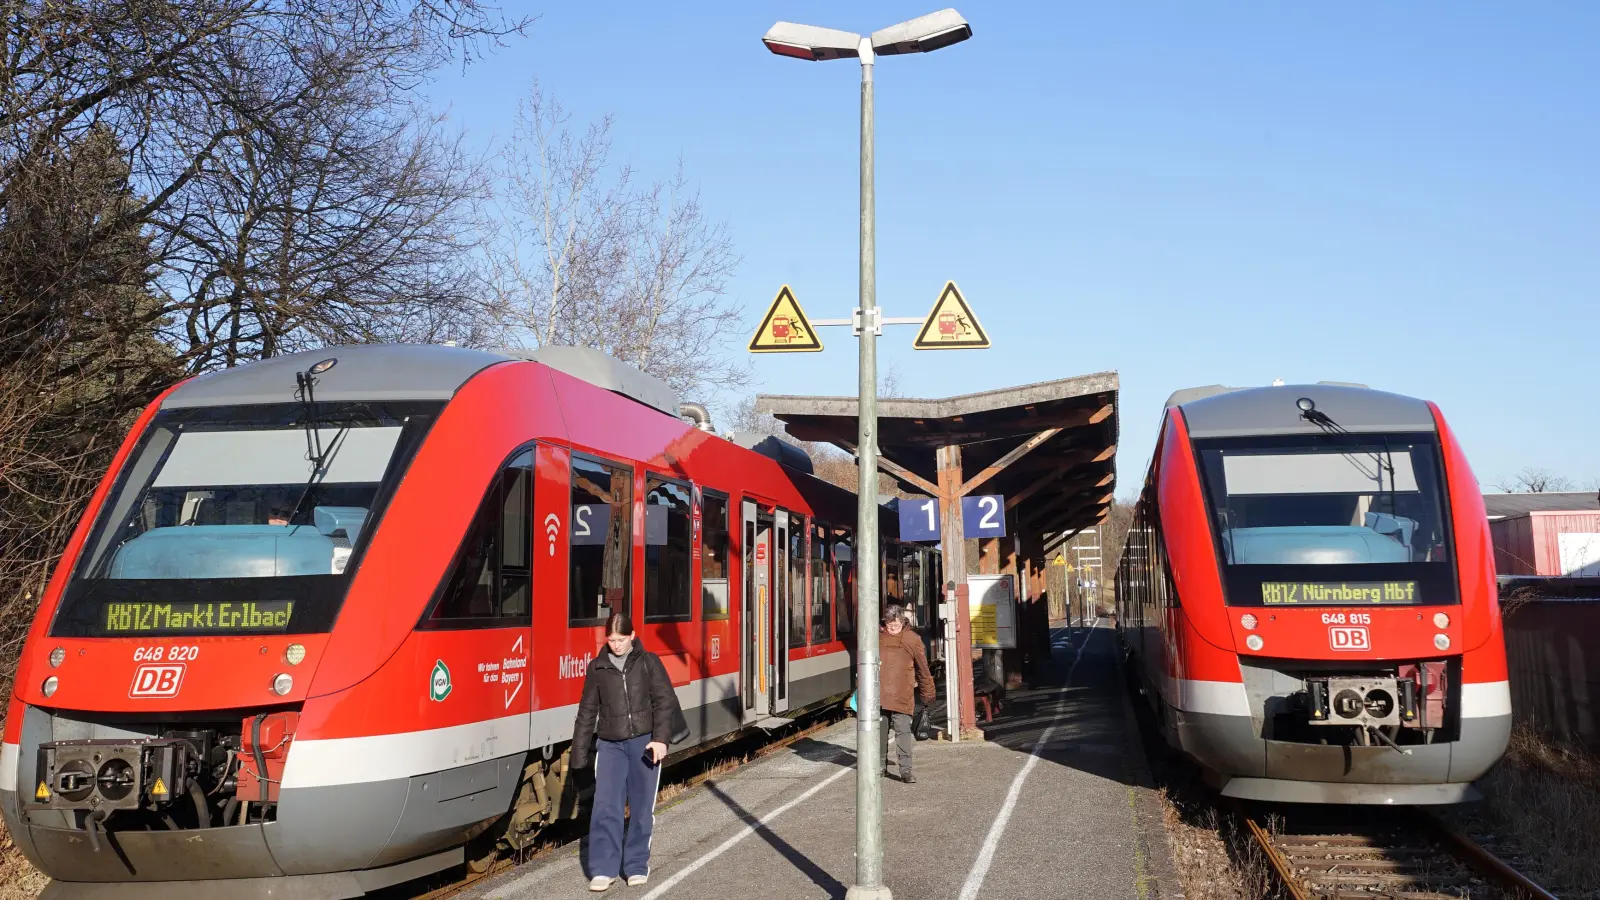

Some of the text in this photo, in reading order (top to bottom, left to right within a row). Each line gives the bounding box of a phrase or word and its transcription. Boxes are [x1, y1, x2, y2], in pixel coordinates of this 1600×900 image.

[921, 500, 936, 531] 1
[978, 496, 1000, 529] 2
[1261, 582, 1415, 603] RB12 Nürnberg Hbf
[107, 602, 153, 631] RB12
[153, 603, 215, 629] Markt
[1321, 613, 1371, 625] 648 815
[1333, 629, 1366, 647] DB
[133, 645, 199, 662] 648 820
[503, 656, 527, 669] Bahnland
[559, 651, 593, 680] Mittelf
[135, 667, 179, 693] DB
[434, 677, 447, 687] VGN
[501, 671, 519, 685] Bayern
